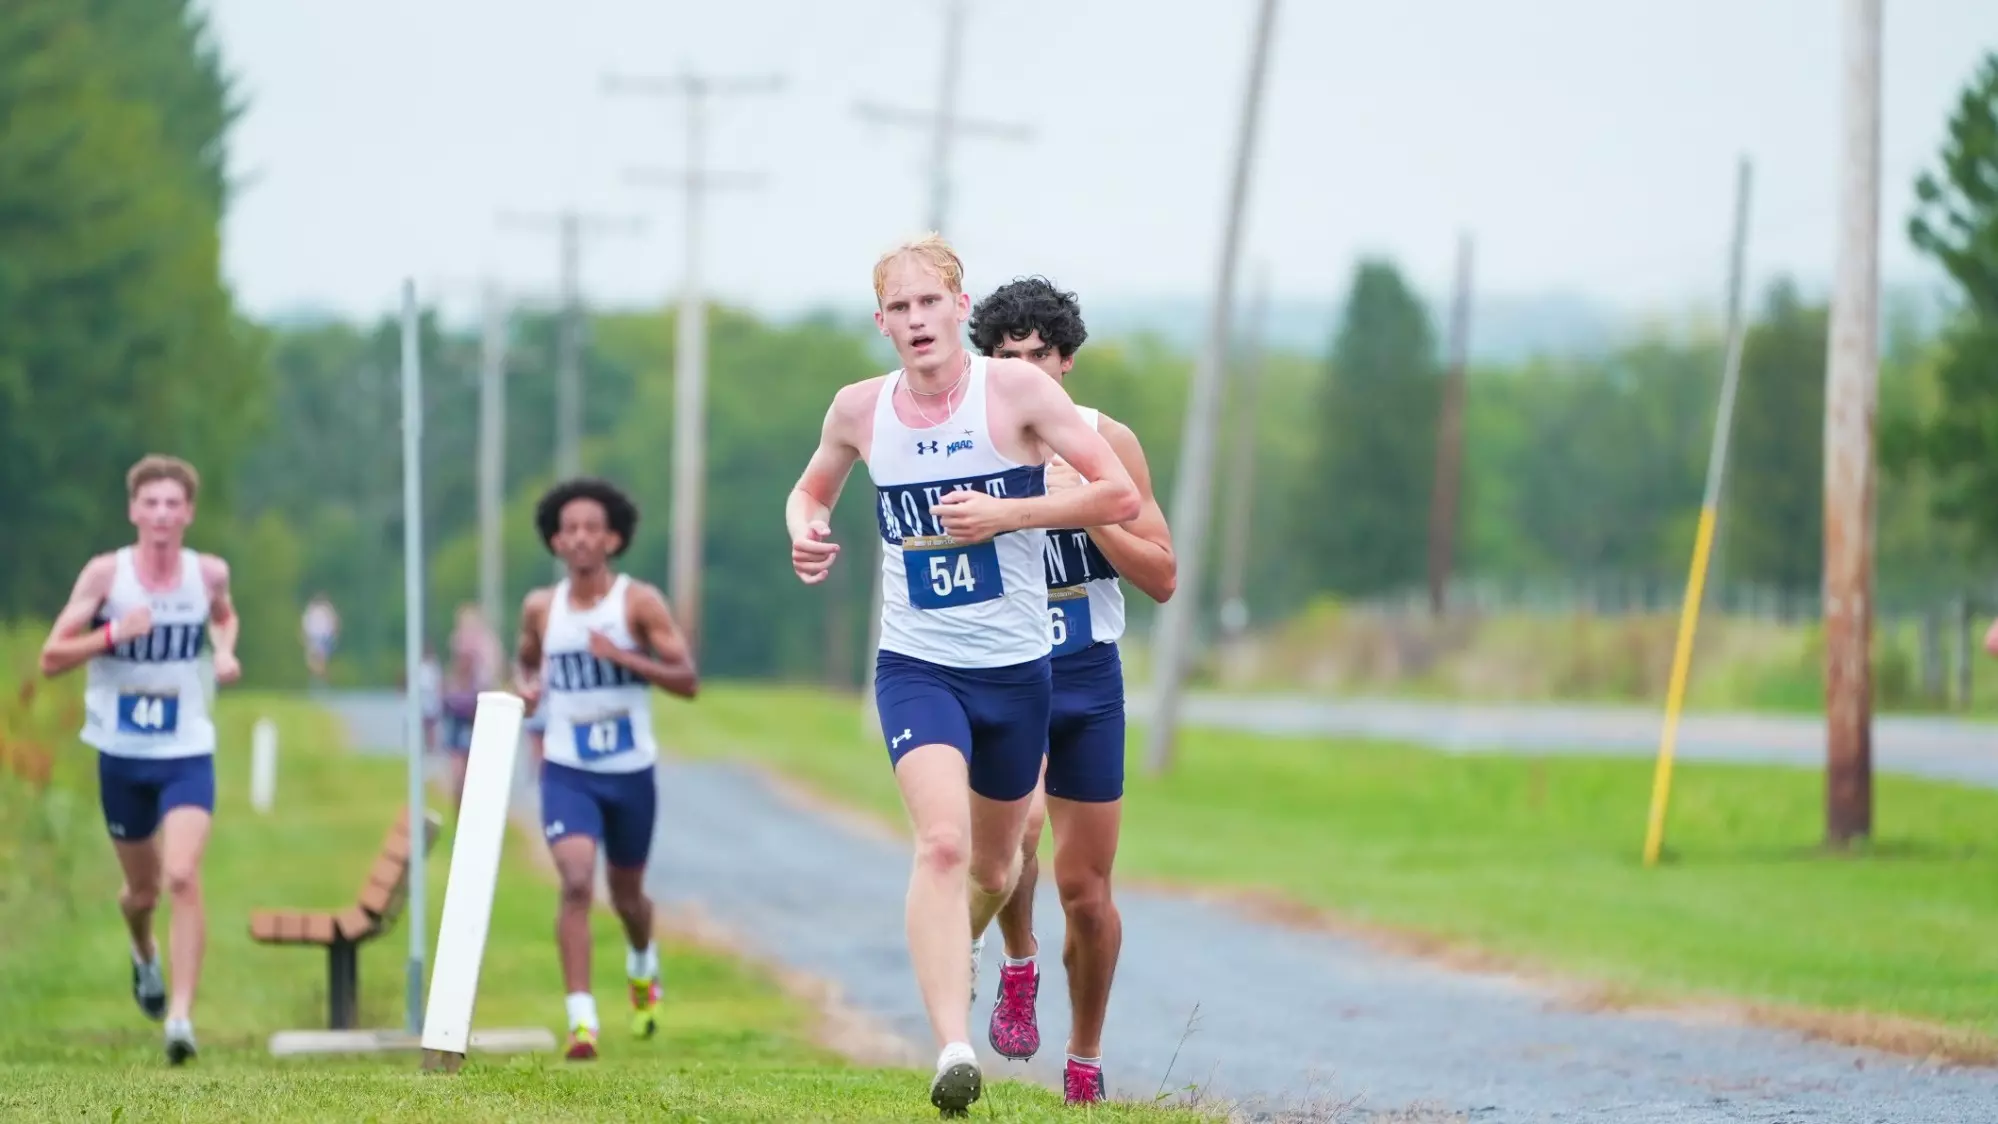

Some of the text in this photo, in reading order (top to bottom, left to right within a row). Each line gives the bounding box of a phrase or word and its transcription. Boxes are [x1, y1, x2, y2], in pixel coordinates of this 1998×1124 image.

[946, 440, 974, 459] MAAC
[929, 553, 975, 596] 54
[131, 696, 163, 728] 44
[588, 721, 618, 752] 47
